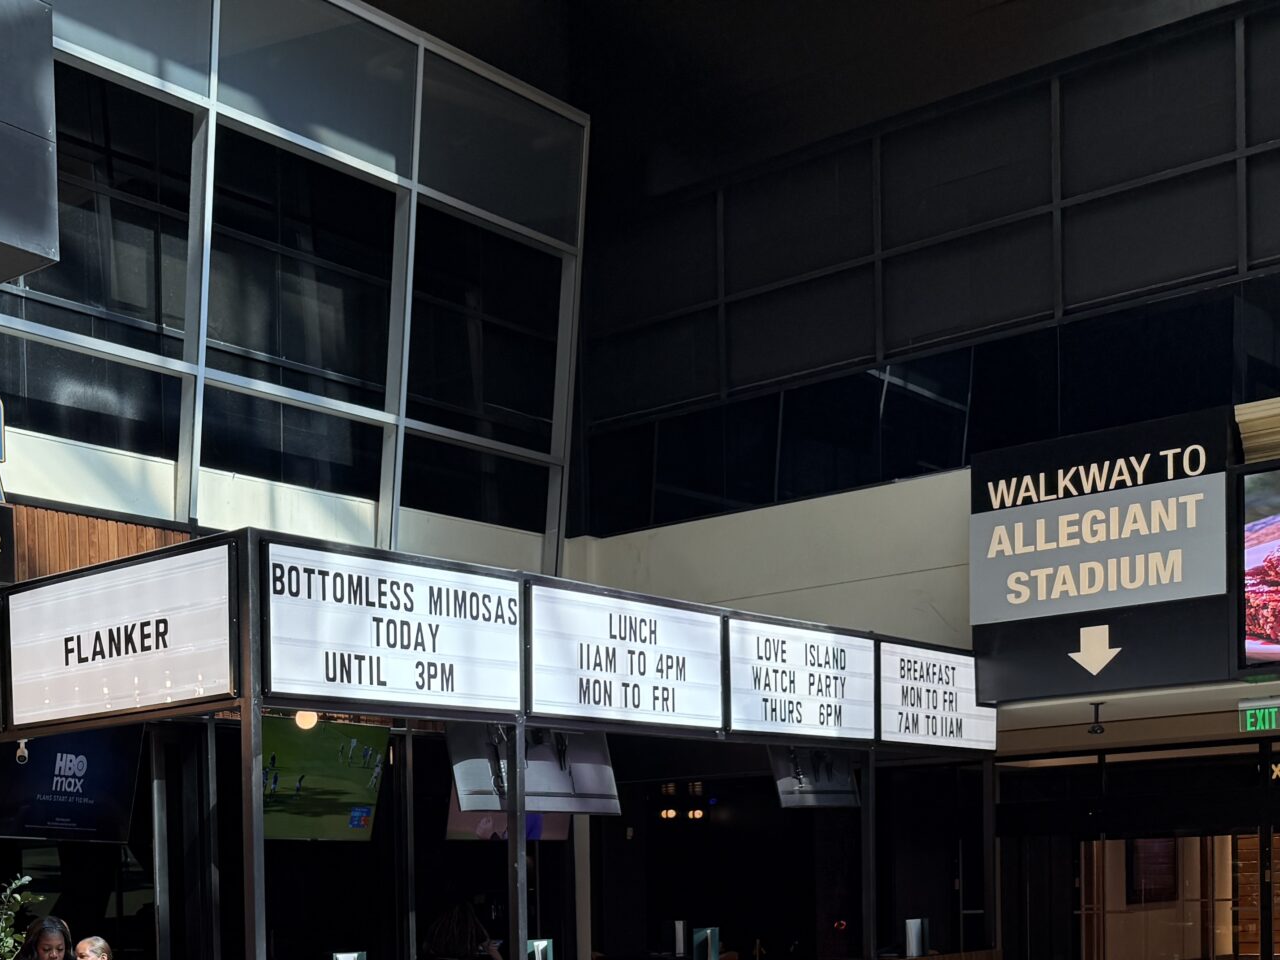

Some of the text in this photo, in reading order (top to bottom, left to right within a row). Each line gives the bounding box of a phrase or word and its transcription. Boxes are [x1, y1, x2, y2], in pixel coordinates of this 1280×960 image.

[987, 444, 1207, 509] WALKWAY TO
[986, 493, 1204, 559] ALLEGIANT
[270, 562, 519, 626] BOTTOMLESS MIMOSAS
[1006, 549, 1183, 605] STADIUM
[63, 618, 170, 667] FLANKER
[372, 616, 440, 654] TODAY
[608, 613, 658, 646] LUNCH
[627, 649, 647, 677] TO
[655, 653, 687, 683] 4PM
[756, 636, 847, 671] LOVE ISLAND
[324, 650, 455, 693] UNTIL 3PM
[752, 665, 847, 700] WATCH PARTY
[899, 658, 957, 688] BREAKFAST
[578, 676, 676, 713] MON TO FRI
[901, 685, 958, 713] MON TO FRI
[762, 697, 843, 728] THURS 6PM
[898, 711, 920, 735] 7AM
[925, 714, 938, 736] TO
[1246, 707, 1278, 731] EXIT
[54, 752, 87, 777] HBO
[52, 776, 84, 793] max
